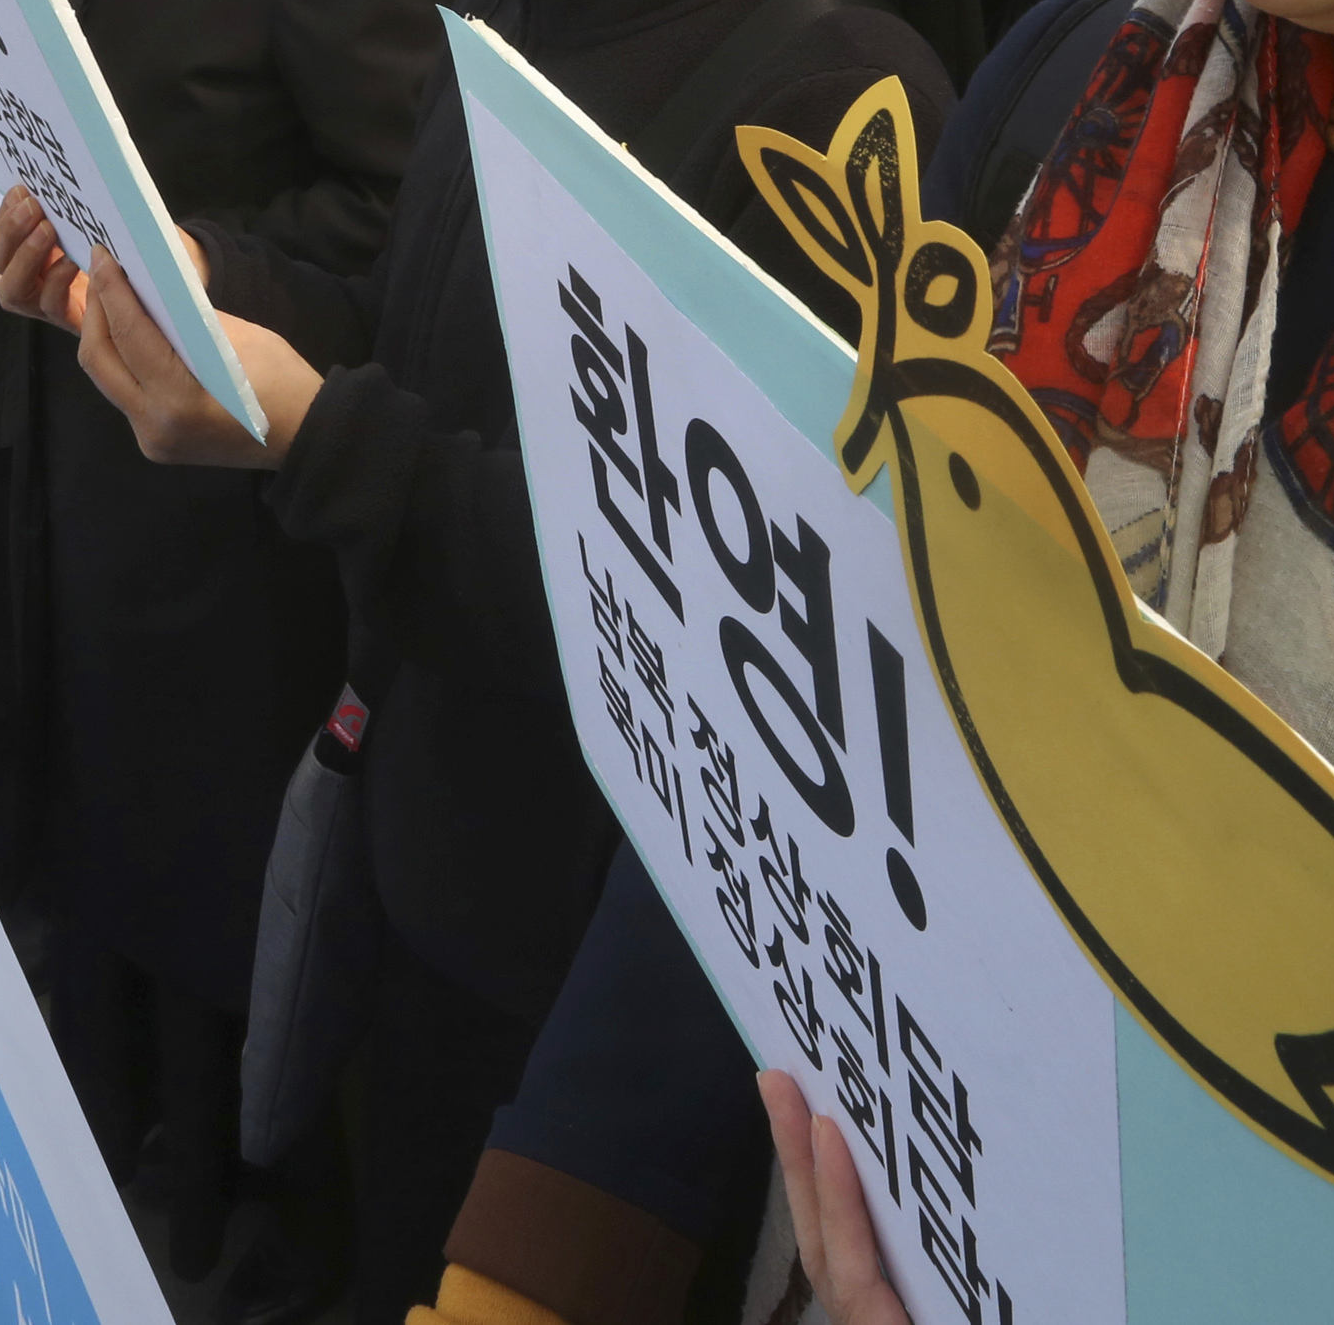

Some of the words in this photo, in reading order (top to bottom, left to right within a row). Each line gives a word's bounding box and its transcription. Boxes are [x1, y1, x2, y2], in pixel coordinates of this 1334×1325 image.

[558, 260, 928, 933] 환영!
[578, 531, 677, 751] 남북
[687, 690, 984, 1211] 정상회담
[596, 644, 694, 868] 북미
